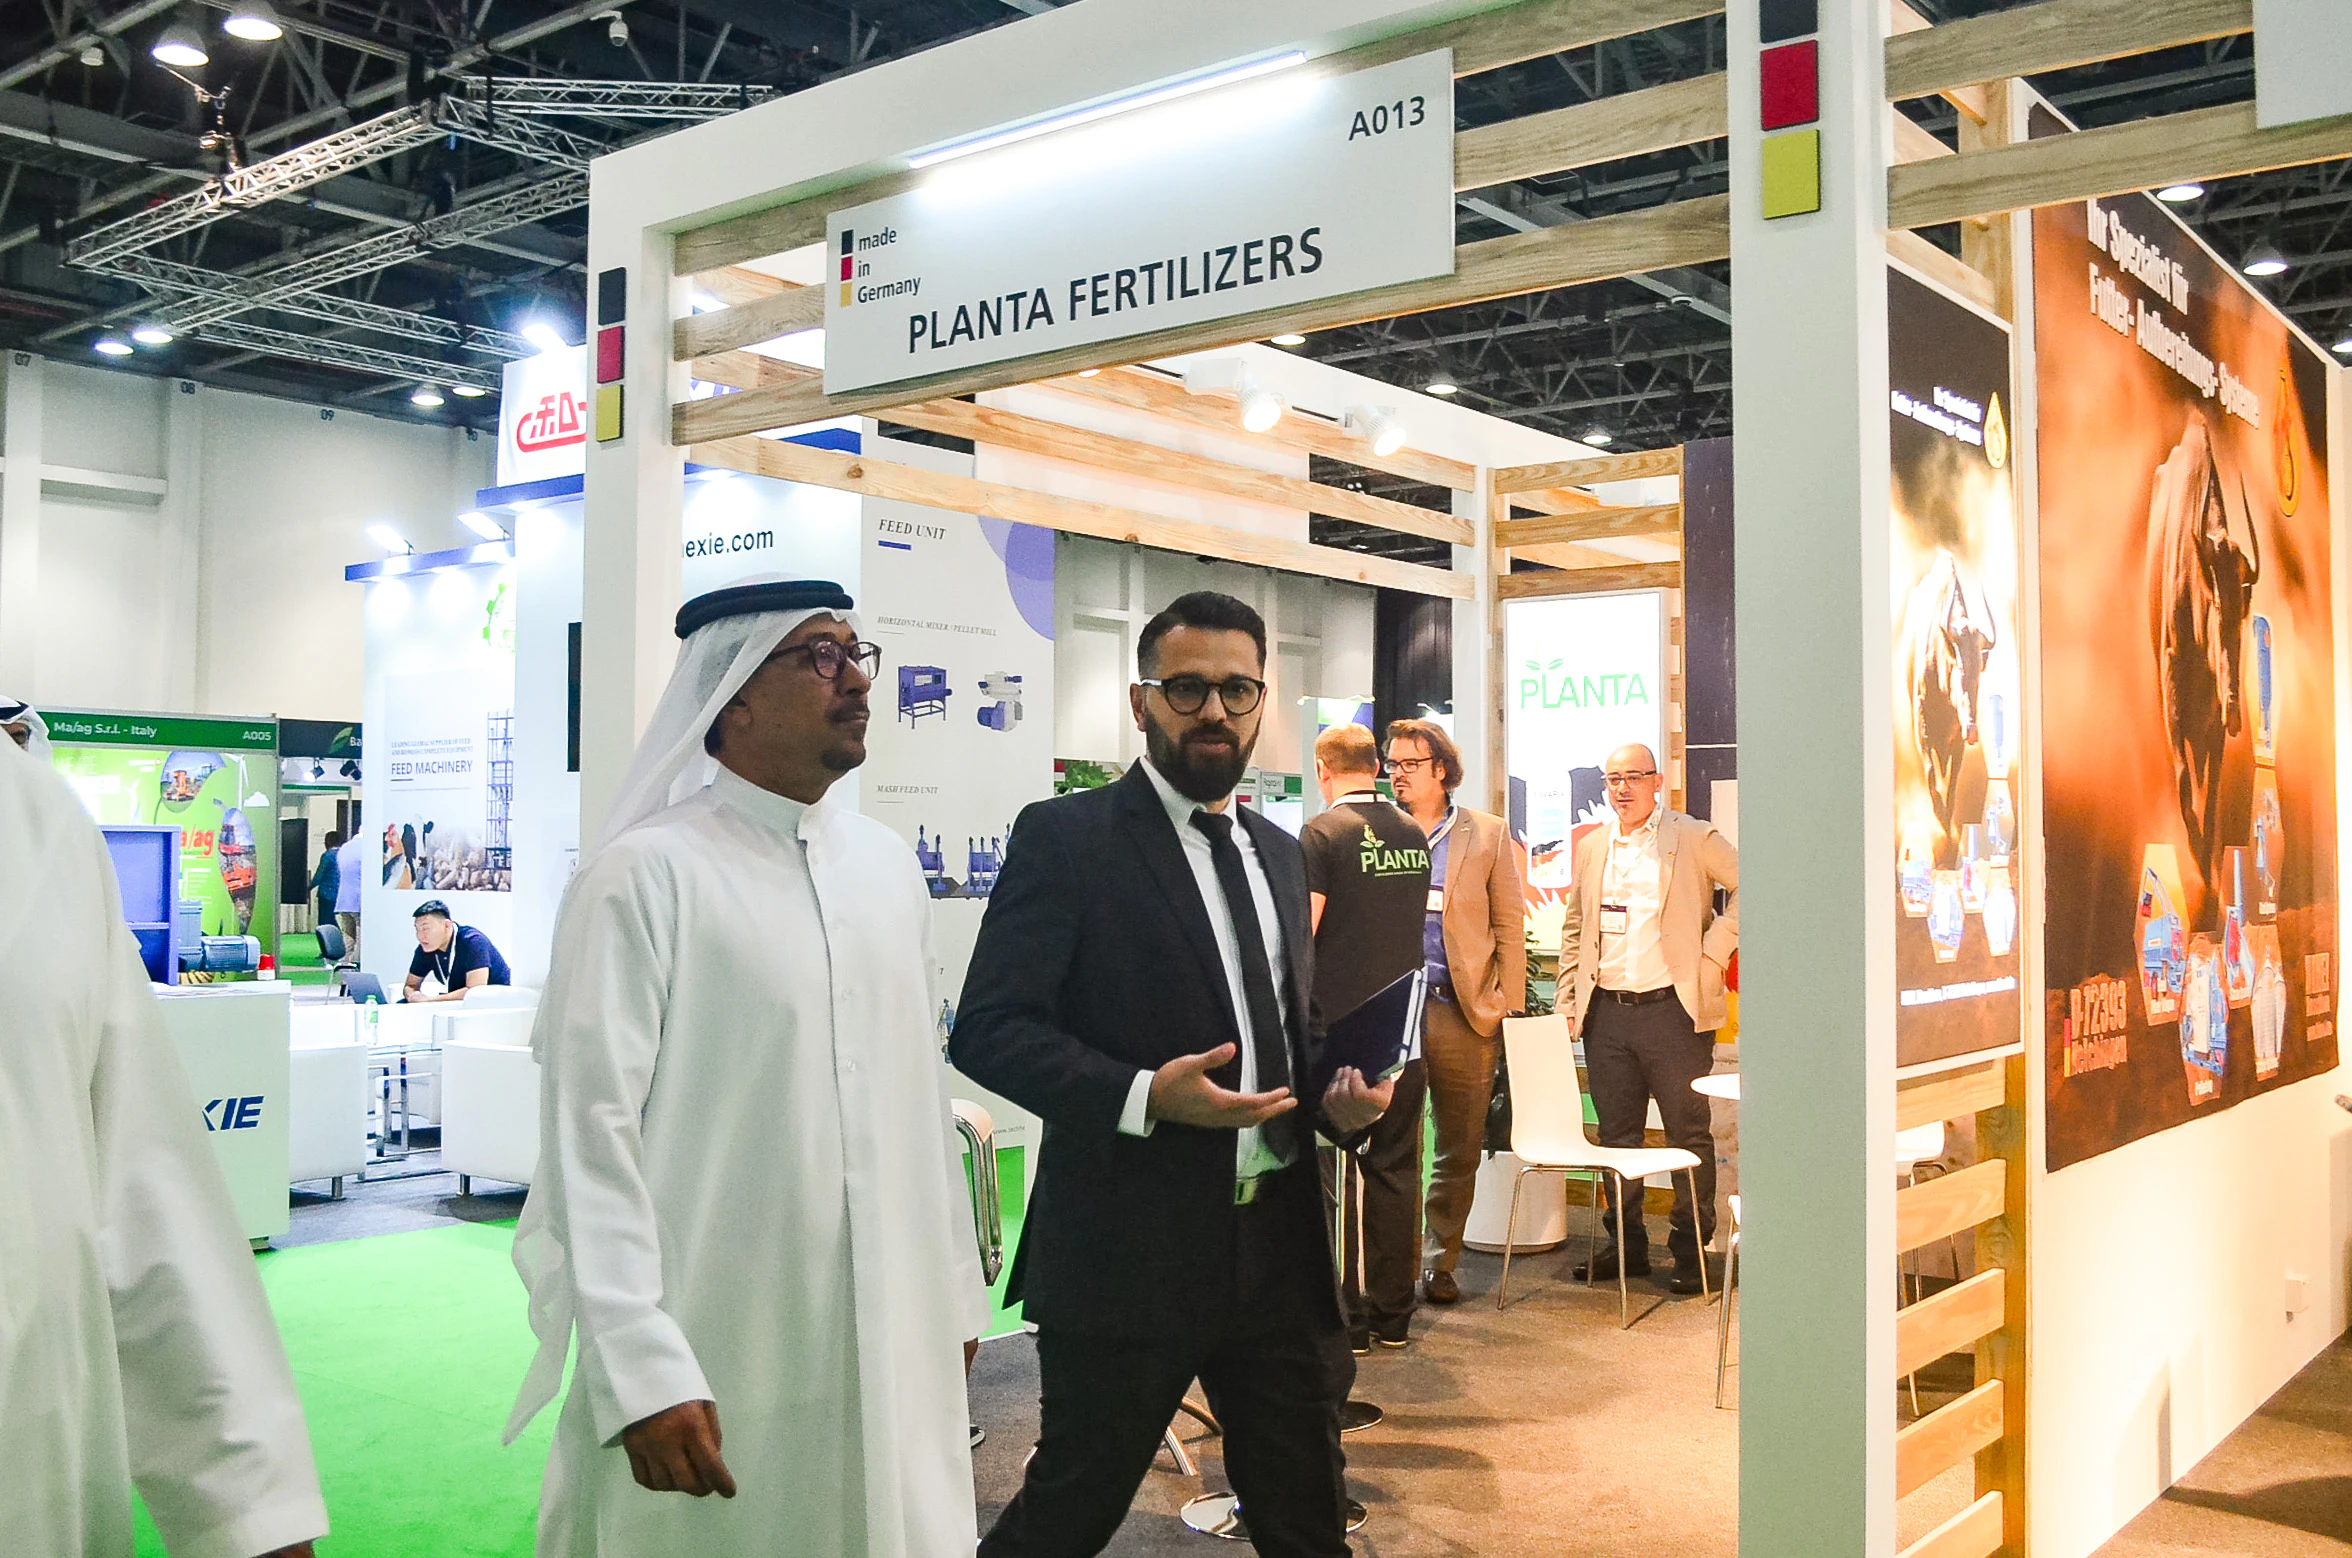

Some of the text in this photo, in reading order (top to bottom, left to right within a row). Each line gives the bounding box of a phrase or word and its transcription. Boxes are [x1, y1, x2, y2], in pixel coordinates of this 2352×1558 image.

[1349, 96, 1426, 141] A013
[858, 227, 897, 251] made
[2109, 210, 2171, 303] Spezialist
[858, 259, 871, 278] in
[857, 275, 921, 304] Germany
[909, 227, 1324, 354] PLANTA FERTILIZERS
[181, 381, 195, 394] 08
[320, 409, 334, 421] 09
[878, 519, 946, 540] FEED UNIT
[682, 530, 773, 558] exie.com
[877, 616, 924, 628] HORIZONTAL
[1521, 673, 1649, 709] PLANTA
[131, 726, 157, 739] Italy
[242, 730, 272, 741] A005
[391, 760, 473, 775] FEED MACHINERY
[1361, 848, 1430, 872] PLANTA
